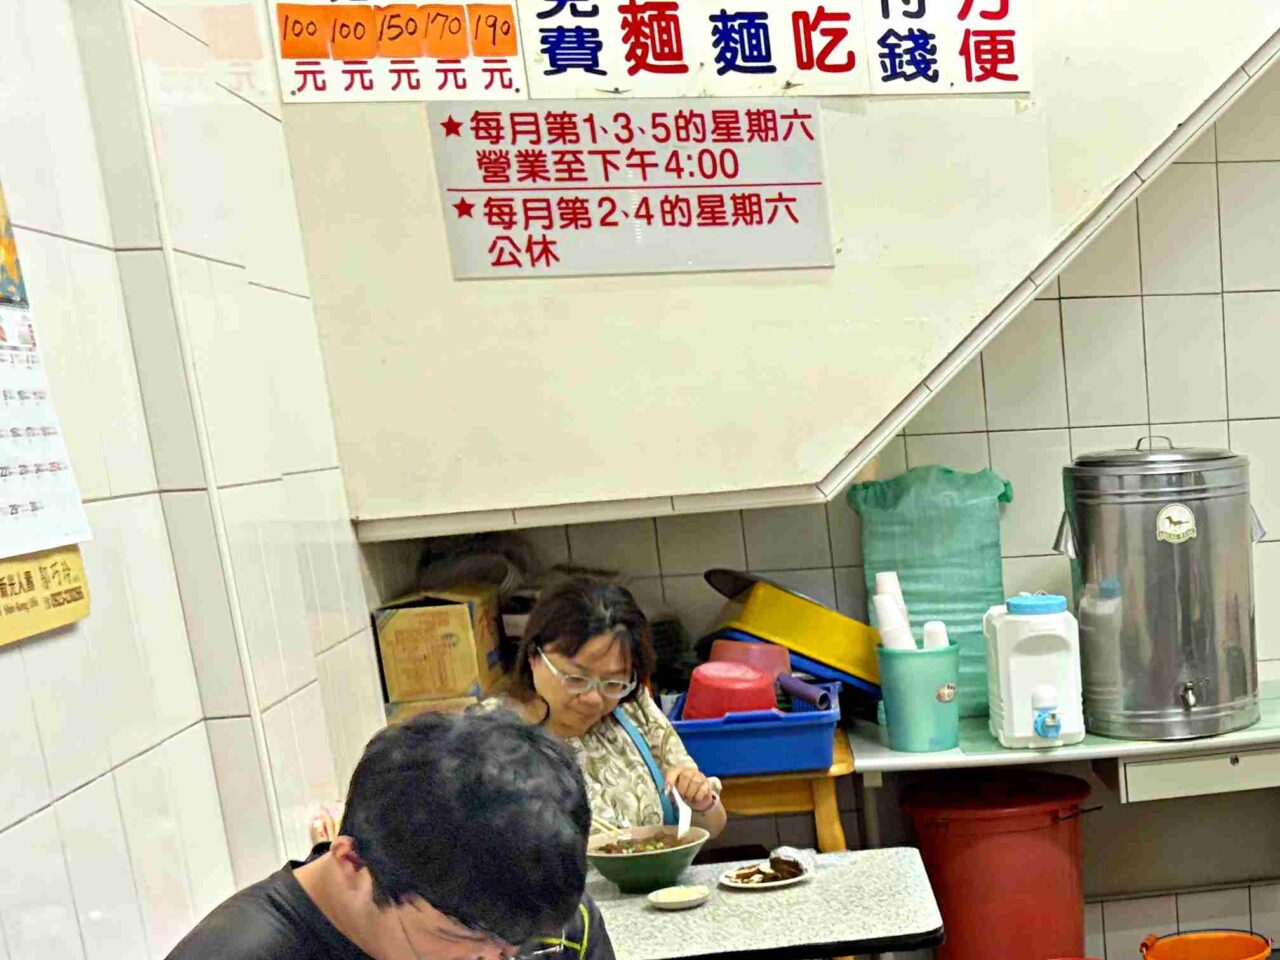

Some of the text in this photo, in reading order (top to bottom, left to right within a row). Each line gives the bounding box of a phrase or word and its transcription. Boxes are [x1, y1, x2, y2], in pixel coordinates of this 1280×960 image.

[282, 14, 318, 41] 100
[332, 18, 366, 43] 100
[379, 13, 418, 41] 150
[424, 12, 462, 40] 170
[475, 13, 511, 45] 190
[792, 6, 856, 73] 吃
[709, 9, 777, 76] 麵
[477, 147, 740, 183] 營業至下午4:00
[488, 234, 561, 268] 公休
